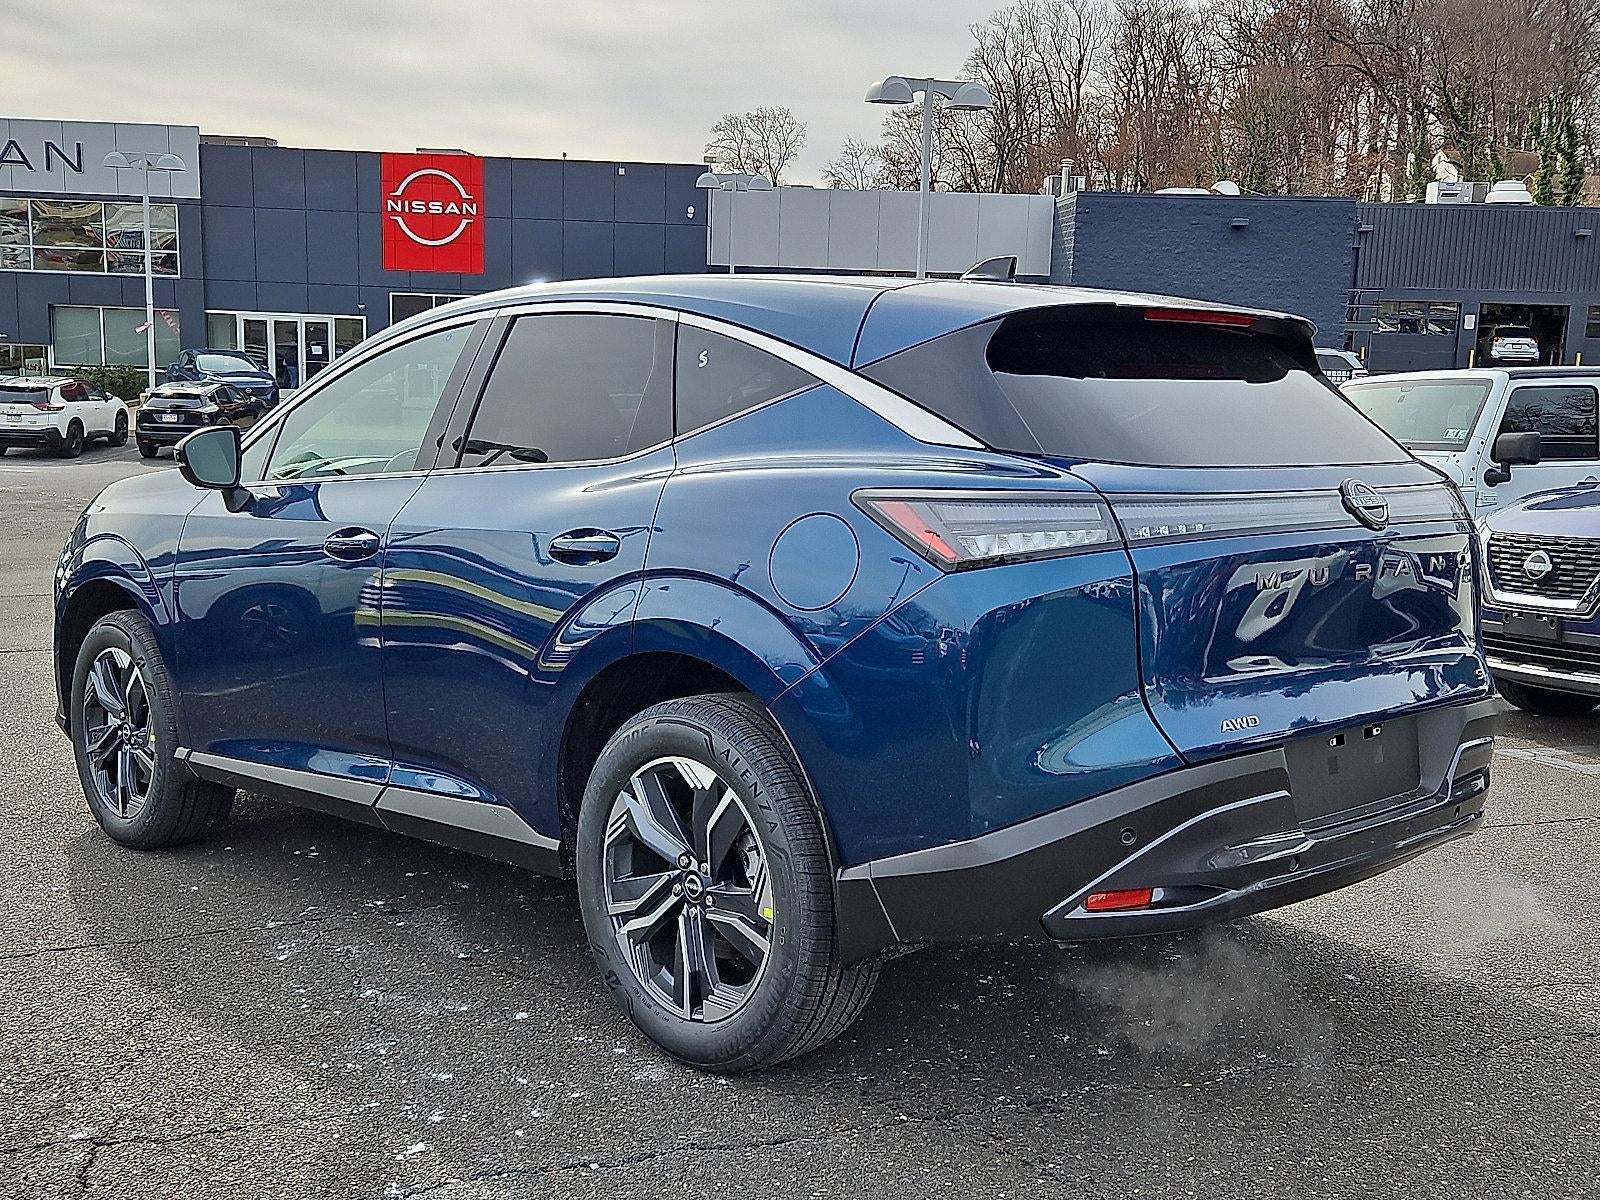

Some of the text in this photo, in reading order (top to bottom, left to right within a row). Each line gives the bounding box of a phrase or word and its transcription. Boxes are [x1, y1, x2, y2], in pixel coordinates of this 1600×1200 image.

[386, 199, 477, 215] NISSAN
[1220, 714, 1260, 733] AWD
[719, 747, 779, 834] ALENZA
